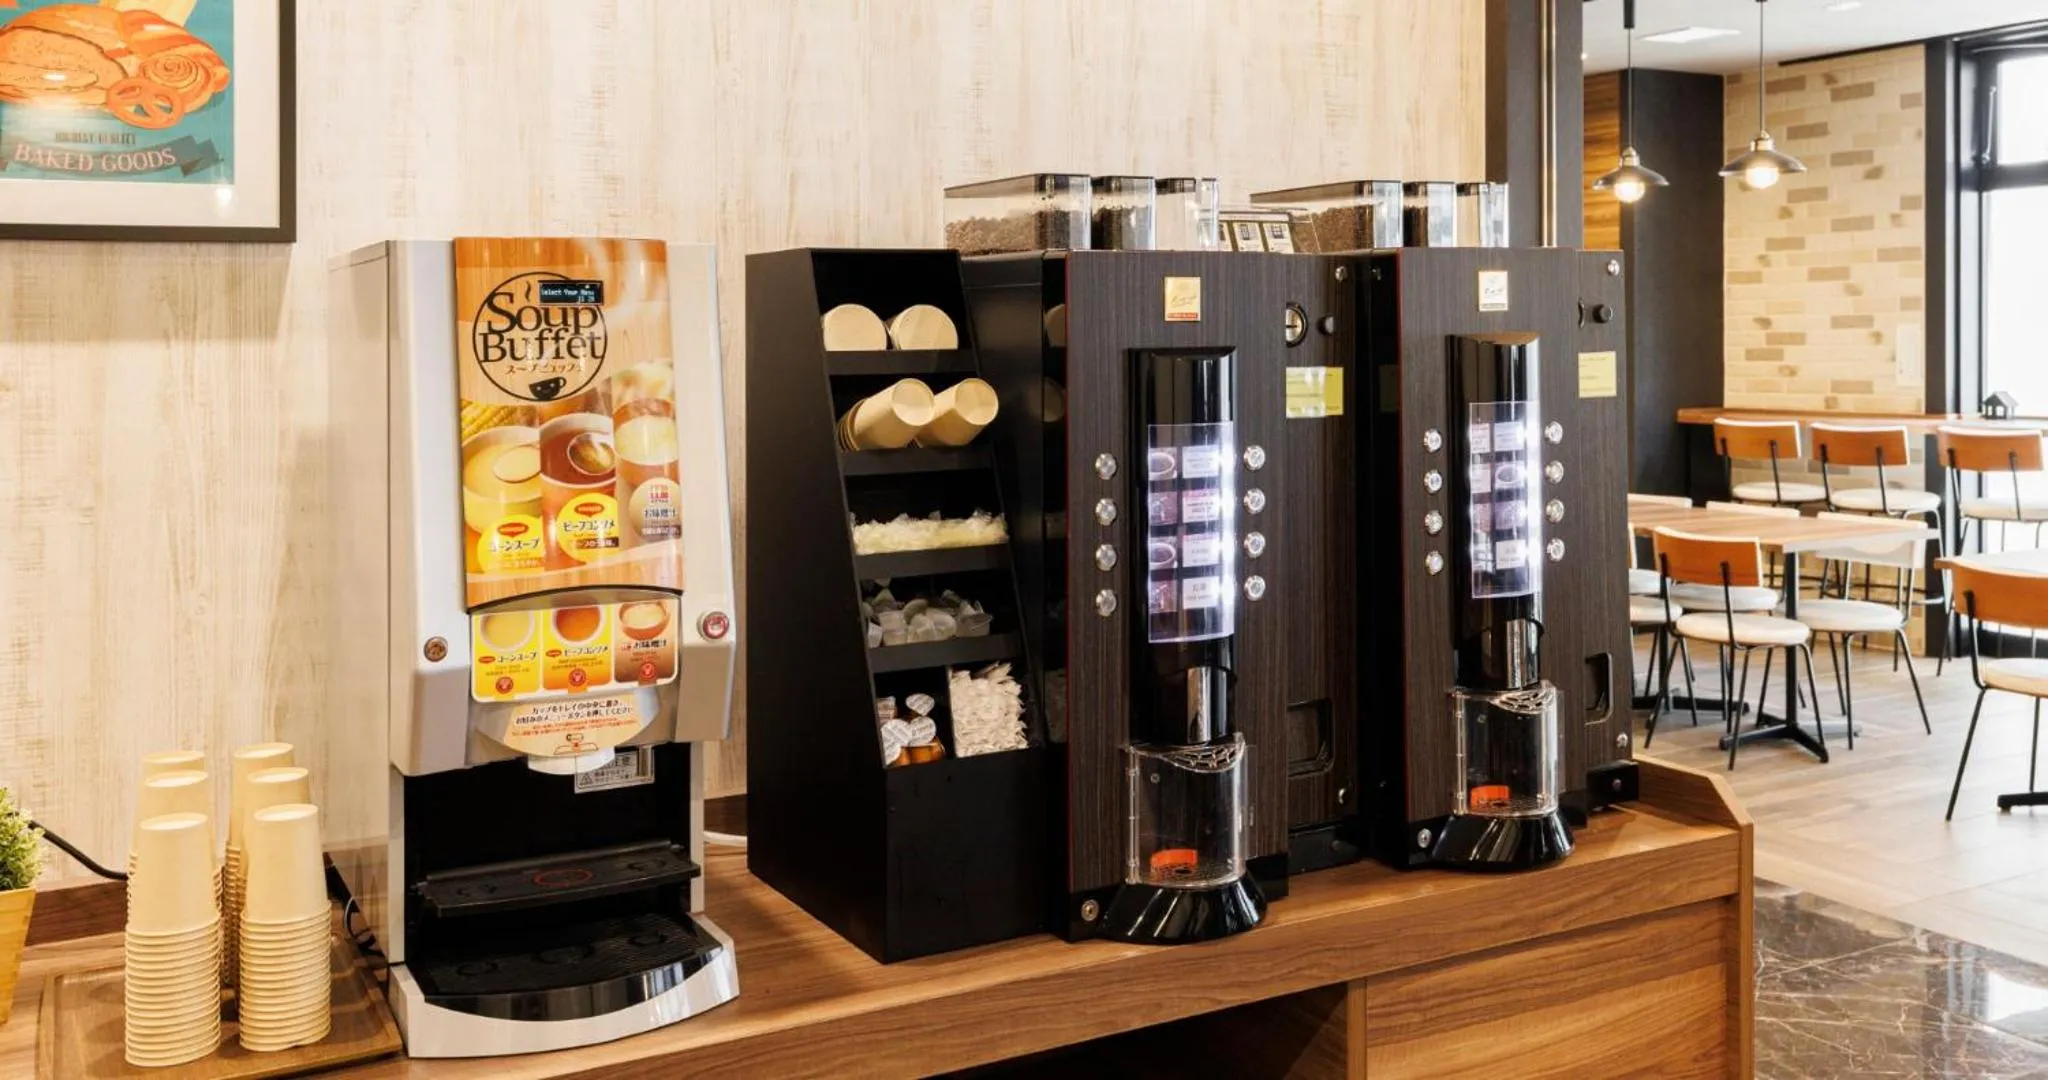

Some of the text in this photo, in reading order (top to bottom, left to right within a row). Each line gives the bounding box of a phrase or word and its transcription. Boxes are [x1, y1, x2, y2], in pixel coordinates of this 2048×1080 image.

[14, 143, 176, 172] BAKED GOODS
[487, 291, 598, 335] Soup
[479, 328, 602, 363] Buffet
